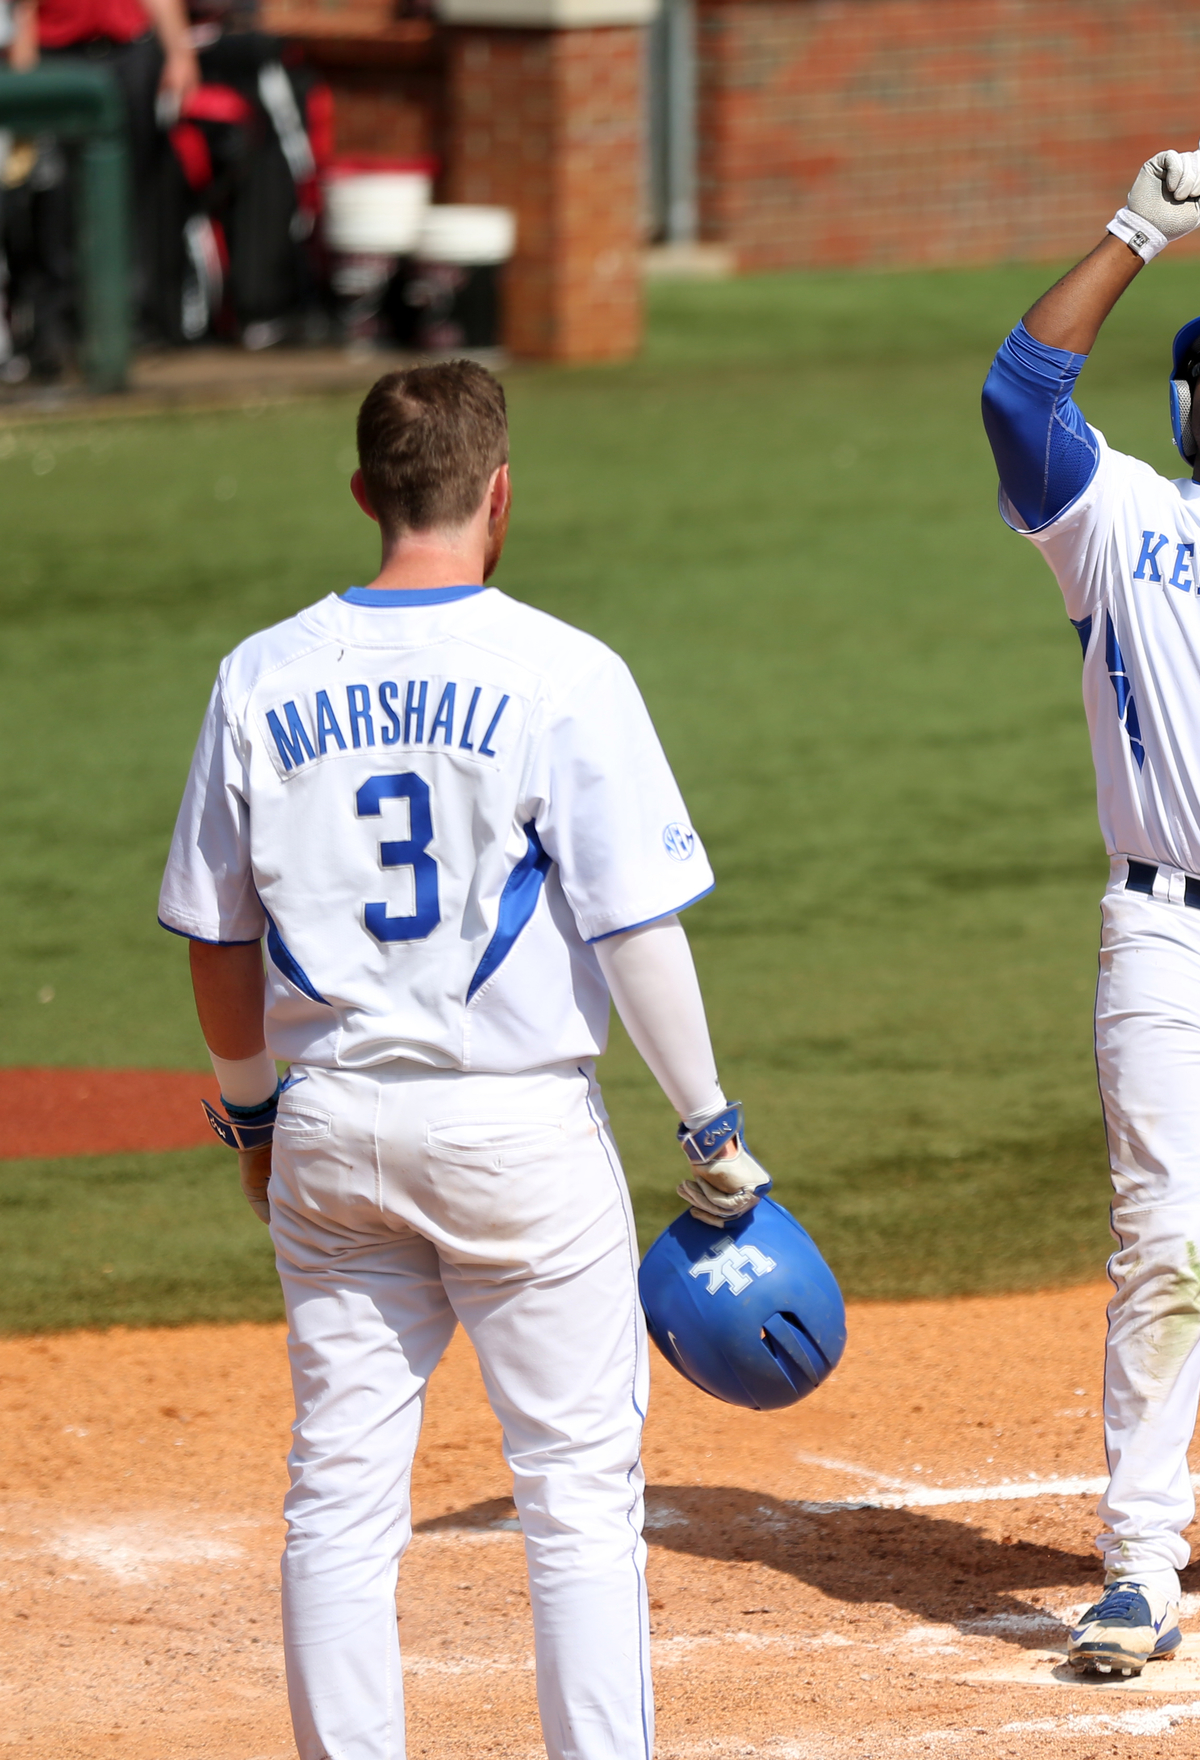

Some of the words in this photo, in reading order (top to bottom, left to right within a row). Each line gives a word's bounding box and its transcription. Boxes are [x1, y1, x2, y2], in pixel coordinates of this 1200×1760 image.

[265, 681, 510, 772] MARSHALL
[355, 771, 441, 944] 3
[663, 823, 694, 861] SEC
